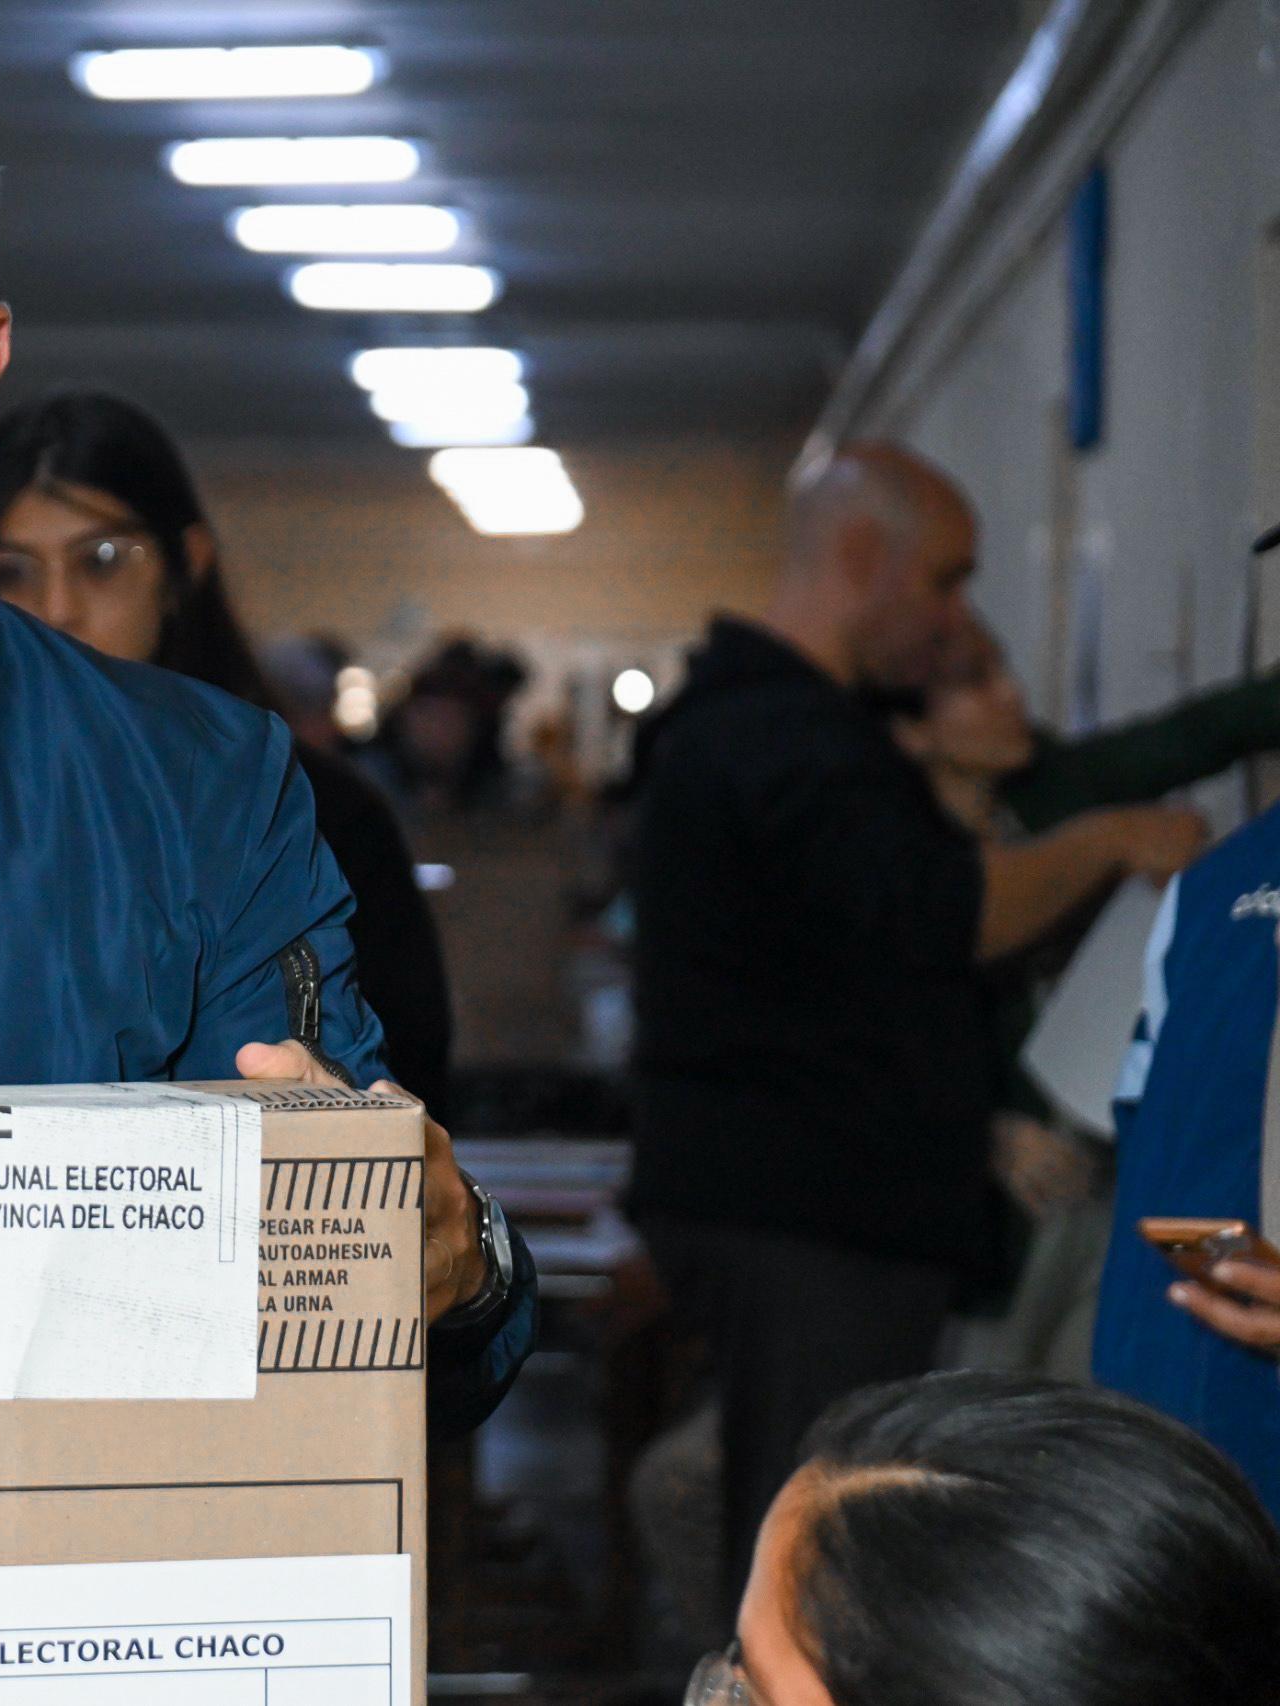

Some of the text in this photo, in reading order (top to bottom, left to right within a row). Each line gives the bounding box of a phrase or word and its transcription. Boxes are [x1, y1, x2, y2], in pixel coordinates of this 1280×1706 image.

[65, 1165, 202, 1191] ELECTORAL
[71, 1204, 114, 1229] DEL
[122, 1204, 205, 1230] CHACO
[321, 1218, 365, 1234] FAJA
[258, 1243, 393, 1261] AUTOADHESIVA
[258, 1269, 349, 1286] AL ARMAR
[284, 1295, 333, 1312] URNA
[174, 1633, 285, 1659] CHACO
